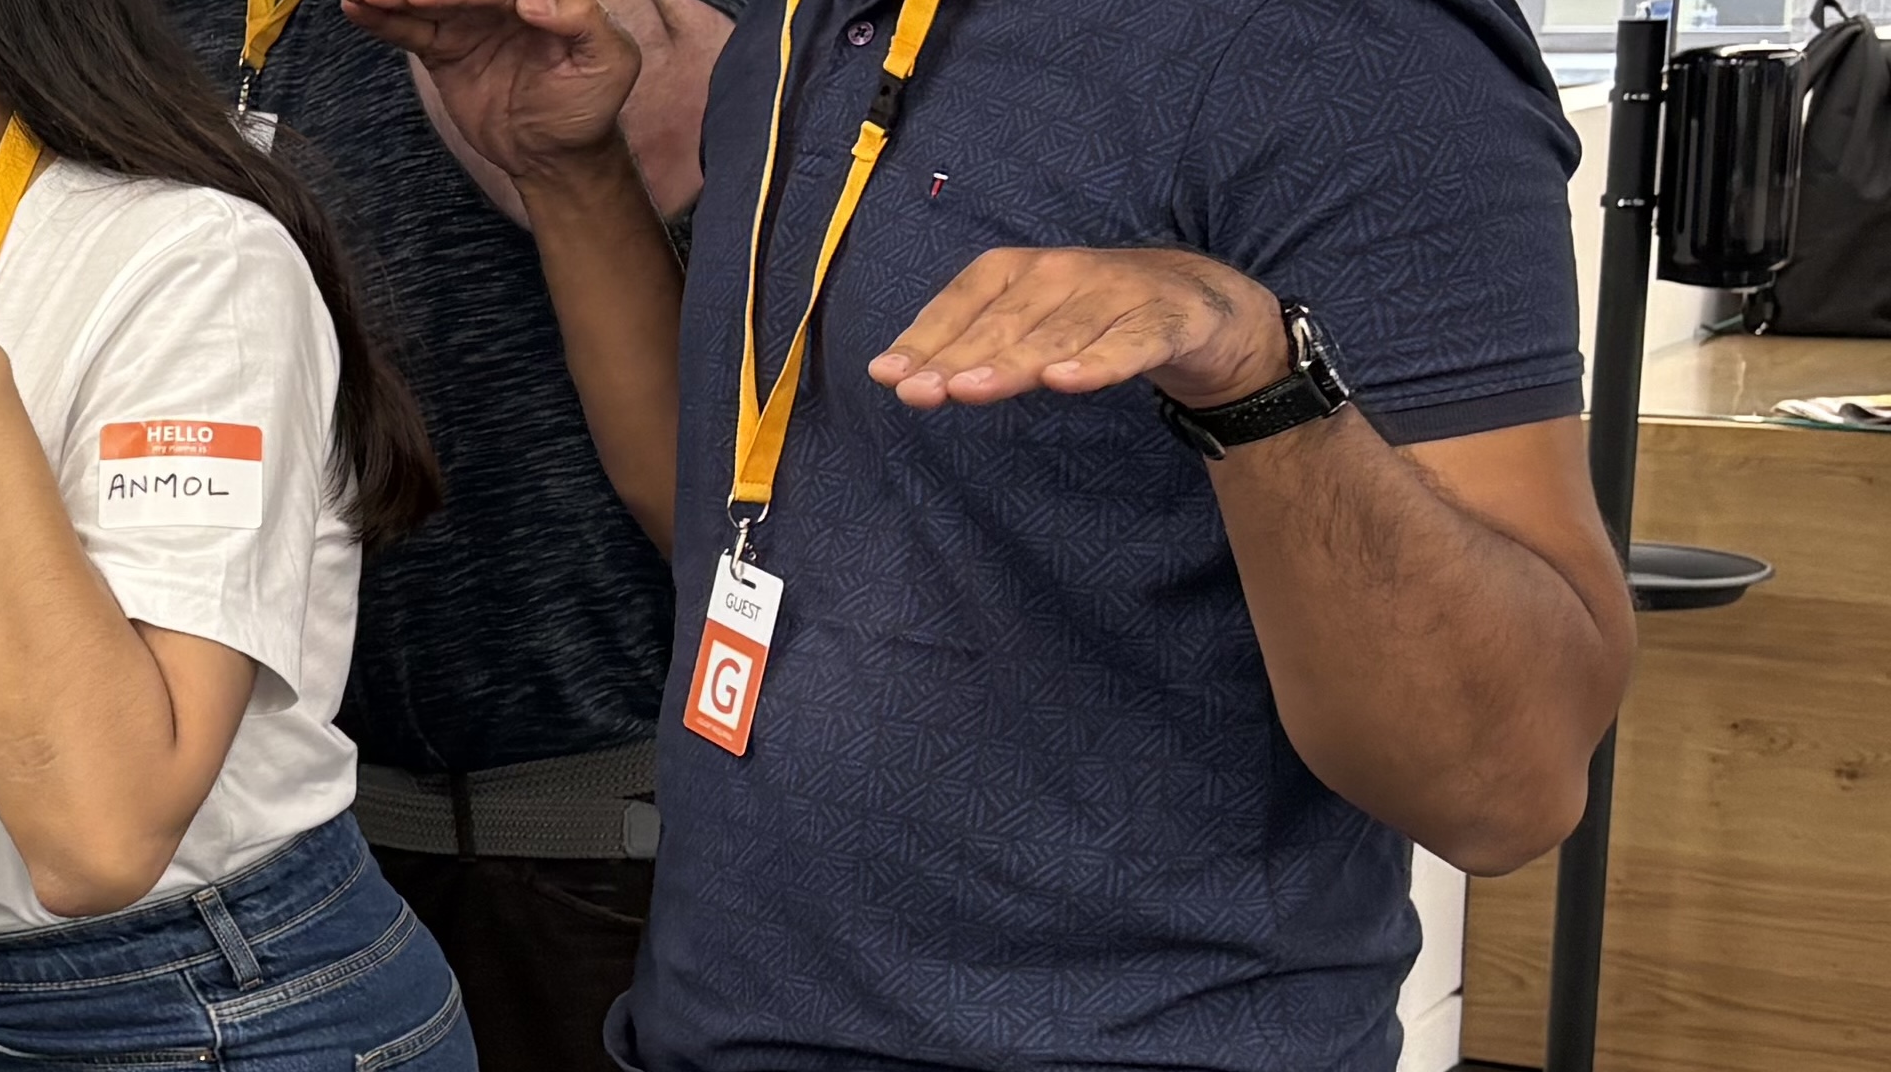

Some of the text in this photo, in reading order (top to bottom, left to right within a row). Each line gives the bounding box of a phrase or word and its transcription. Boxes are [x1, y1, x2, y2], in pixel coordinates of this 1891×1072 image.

[147, 426, 214, 444] HELLO
[108, 473, 230, 501] ANMOL
[725, 592, 763, 622] GUEST
[710, 657, 742, 715] G
